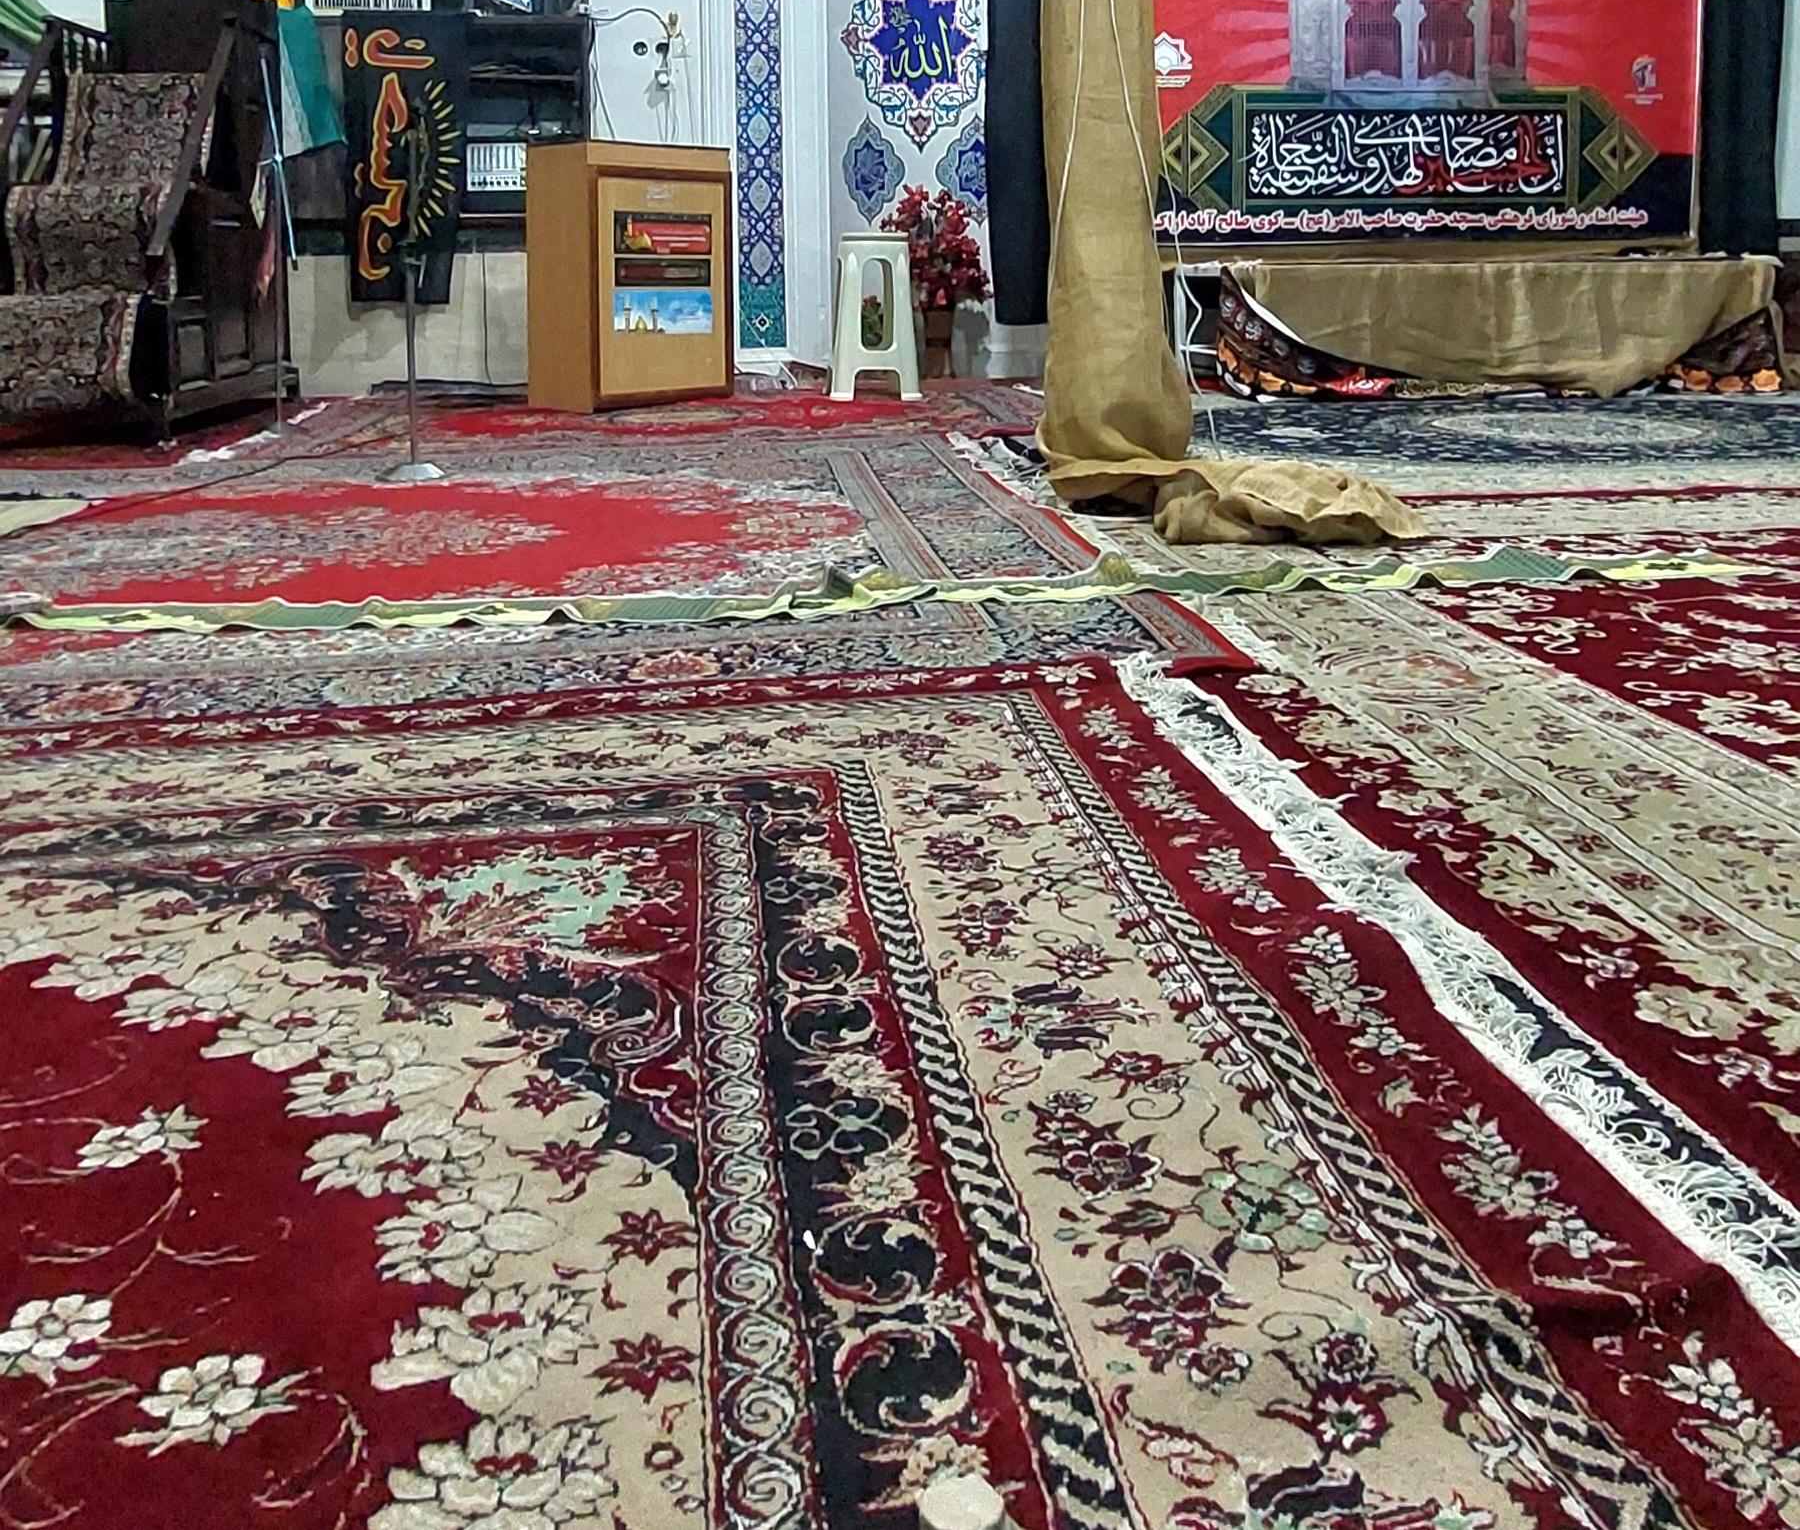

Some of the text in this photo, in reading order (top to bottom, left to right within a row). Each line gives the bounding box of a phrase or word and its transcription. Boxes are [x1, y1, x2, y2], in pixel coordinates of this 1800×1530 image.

[889, 14, 953, 79] الله
[1187, 208, 1217, 233] آباد
[1216, 209, 1251, 233] صالح
[1252, 209, 1284, 233] کوی
[1363, 208, 1403, 231] صاحب
[1404, 208, 1447, 232] حضرت
[1448, 211, 1486, 230] مسجد
[1486, 206, 1534, 230] فرهنگی
